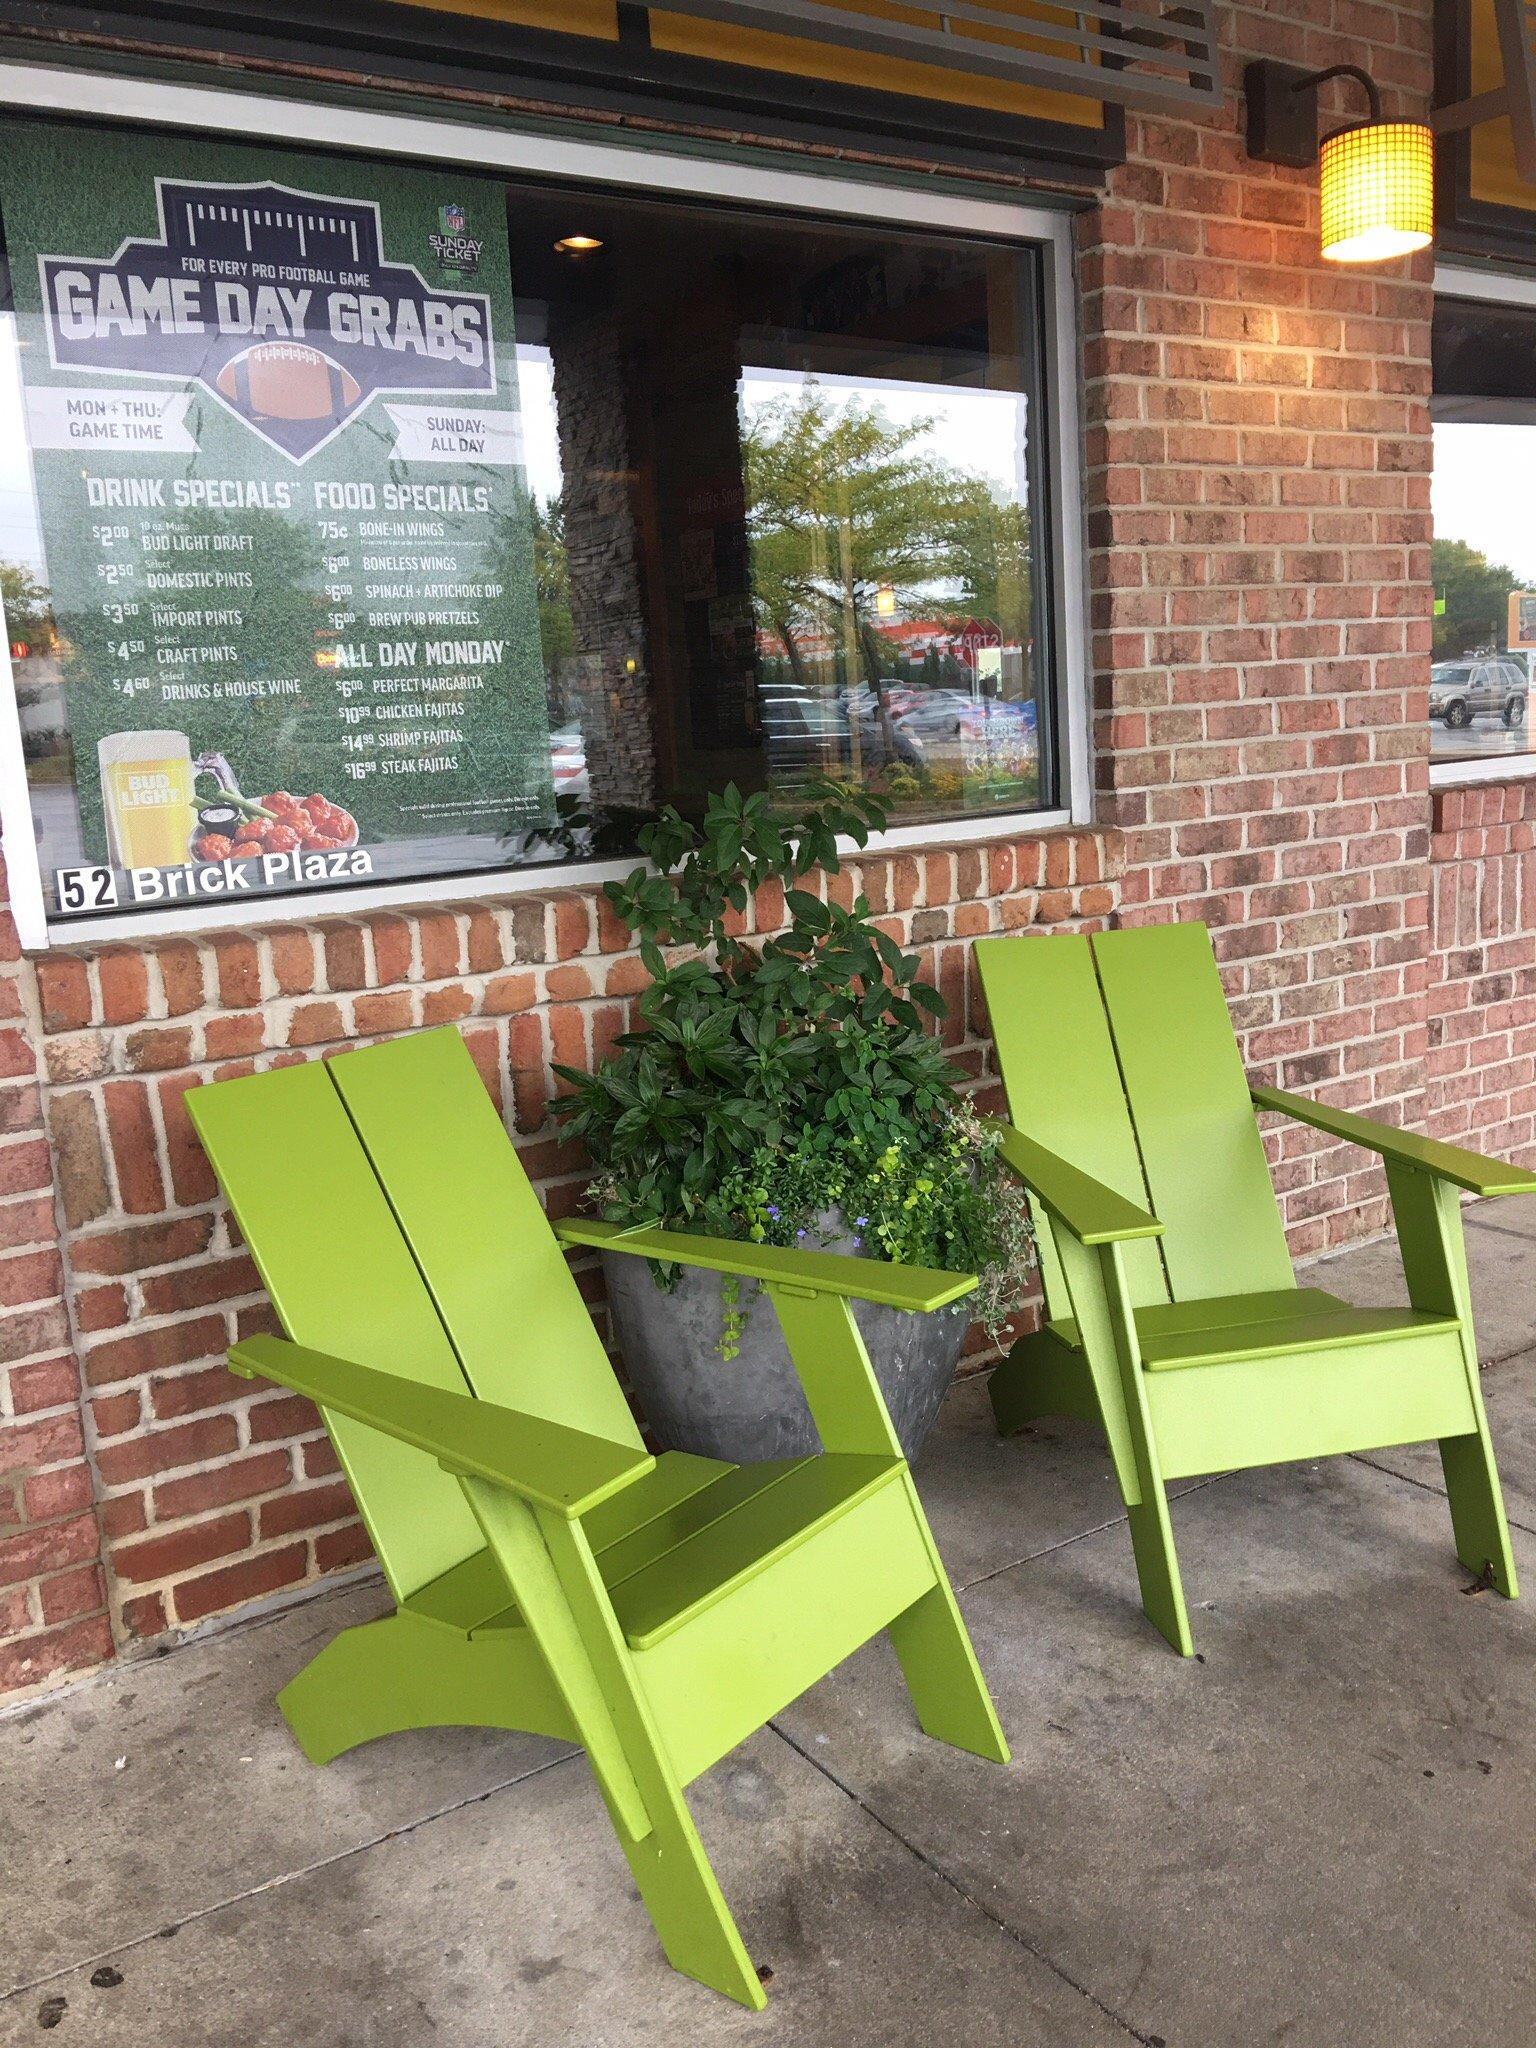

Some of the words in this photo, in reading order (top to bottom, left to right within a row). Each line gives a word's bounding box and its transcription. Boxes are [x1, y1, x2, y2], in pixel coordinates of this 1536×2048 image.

[428, 234, 483, 252] SUNDAY
[434, 246, 481, 262] TICKET
[181, 257, 206, 273] FOR
[209, 258, 248, 277] EVERY
[252, 263, 276, 279] PRO
[279, 267, 336, 285] FOOTBALL
[339, 273, 371, 288] GAME
[54, 270, 205, 340] GAME
[214, 281, 313, 338] DAY
[327, 292, 484, 368] GRABS
[67, 399, 106, 416] MON
[122, 401, 162, 418] THU:
[69, 422, 119, 439] GAME
[122, 423, 164, 440] TIME
[427, 417, 486, 433] SUNDAY:
[431, 437, 456, 451] ALL
[459, 438, 485, 453] DAY
[87, 478, 166, 507] DRINK
[314, 482, 376, 509] FOOD
[359, 522, 405, 537] BONE-IN
[407, 522, 445, 537] WINGS
[141, 535, 170, 550] BUD
[173, 535, 210, 550] LIGHT
[213, 535, 253, 550] DRAFT
[363, 557, 418, 571] BONELESS
[420, 557, 457, 571] WINGS
[147, 573, 214, 589] DOMESTIC
[216, 572, 253, 587] PINTS
[365, 585, 413, 599] SPINACH
[424, 585, 483, 599] ARTICHOKE
[485, 584, 503, 597] DIP
[152, 611, 201, 627] IMPORT
[205, 610, 243, 626] PINTS
[369, 612, 401, 627] BREW
[404, 612, 426, 626] PUB
[428, 612, 479, 625] PRETZELS
[157, 647, 198, 664] CRAFT
[201, 646, 238, 662] PINTS
[335, 643, 373, 668] ALL
[379, 642, 418, 667] DAY
[162, 684, 210, 700] DRINKS
[213, 684, 223, 698] &
[225, 681, 266, 698] HOUSE
[268, 679, 302, 694] WINE
[373, 678, 419, 694] PERFECT
[421, 676, 484, 691] MARGARITA
[376, 704, 422, 719] CHICKEN
[424, 702, 465, 718] FAJITAS
[379, 732, 420, 747] SHRIMP
[423, 729, 463, 745] FAJITAS
[381, 759, 416, 775] STEAK
[418, 757, 459, 773] FAJITAS
[129, 774, 169, 790] BUD
[120, 789, 178, 807] LIGHT
[61, 869, 115, 908] 52
[131, 857, 251, 902] Brick
[262, 848, 374, 886] Plaza
